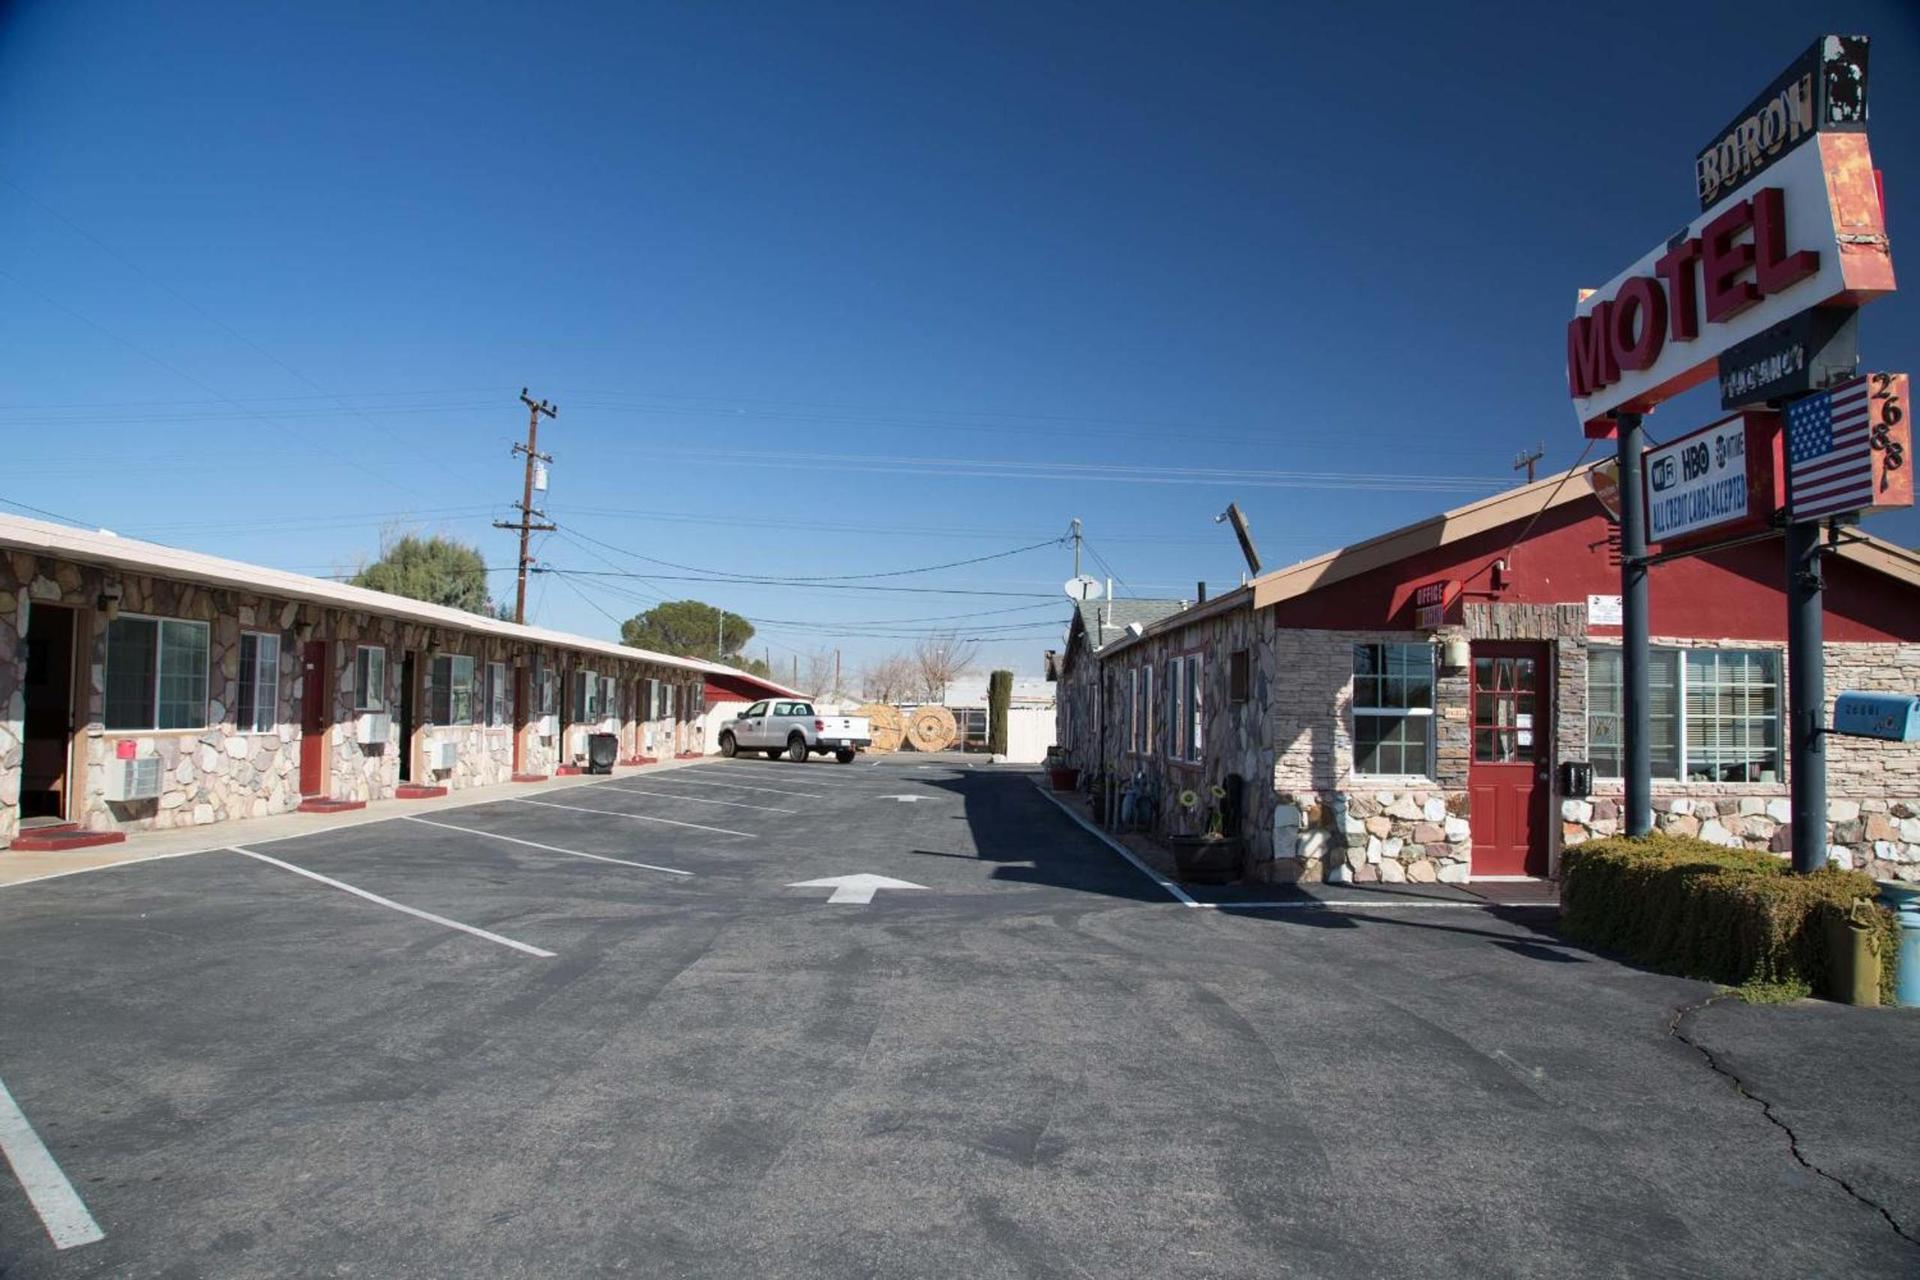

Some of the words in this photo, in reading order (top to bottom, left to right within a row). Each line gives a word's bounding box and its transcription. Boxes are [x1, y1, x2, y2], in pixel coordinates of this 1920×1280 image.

[1699, 72, 1813, 203] BORON
[1568, 187, 1820, 399] MOTEL
[1681, 441, 1709, 482] HBO
[1653, 502, 1665, 533] ALL
[1666, 493, 1688, 531] CREDIT
[1689, 486, 1710, 523] CARDS
[1711, 474, 1746, 517] ACCEPTED
[1417, 584, 1443, 605] OFFICE
